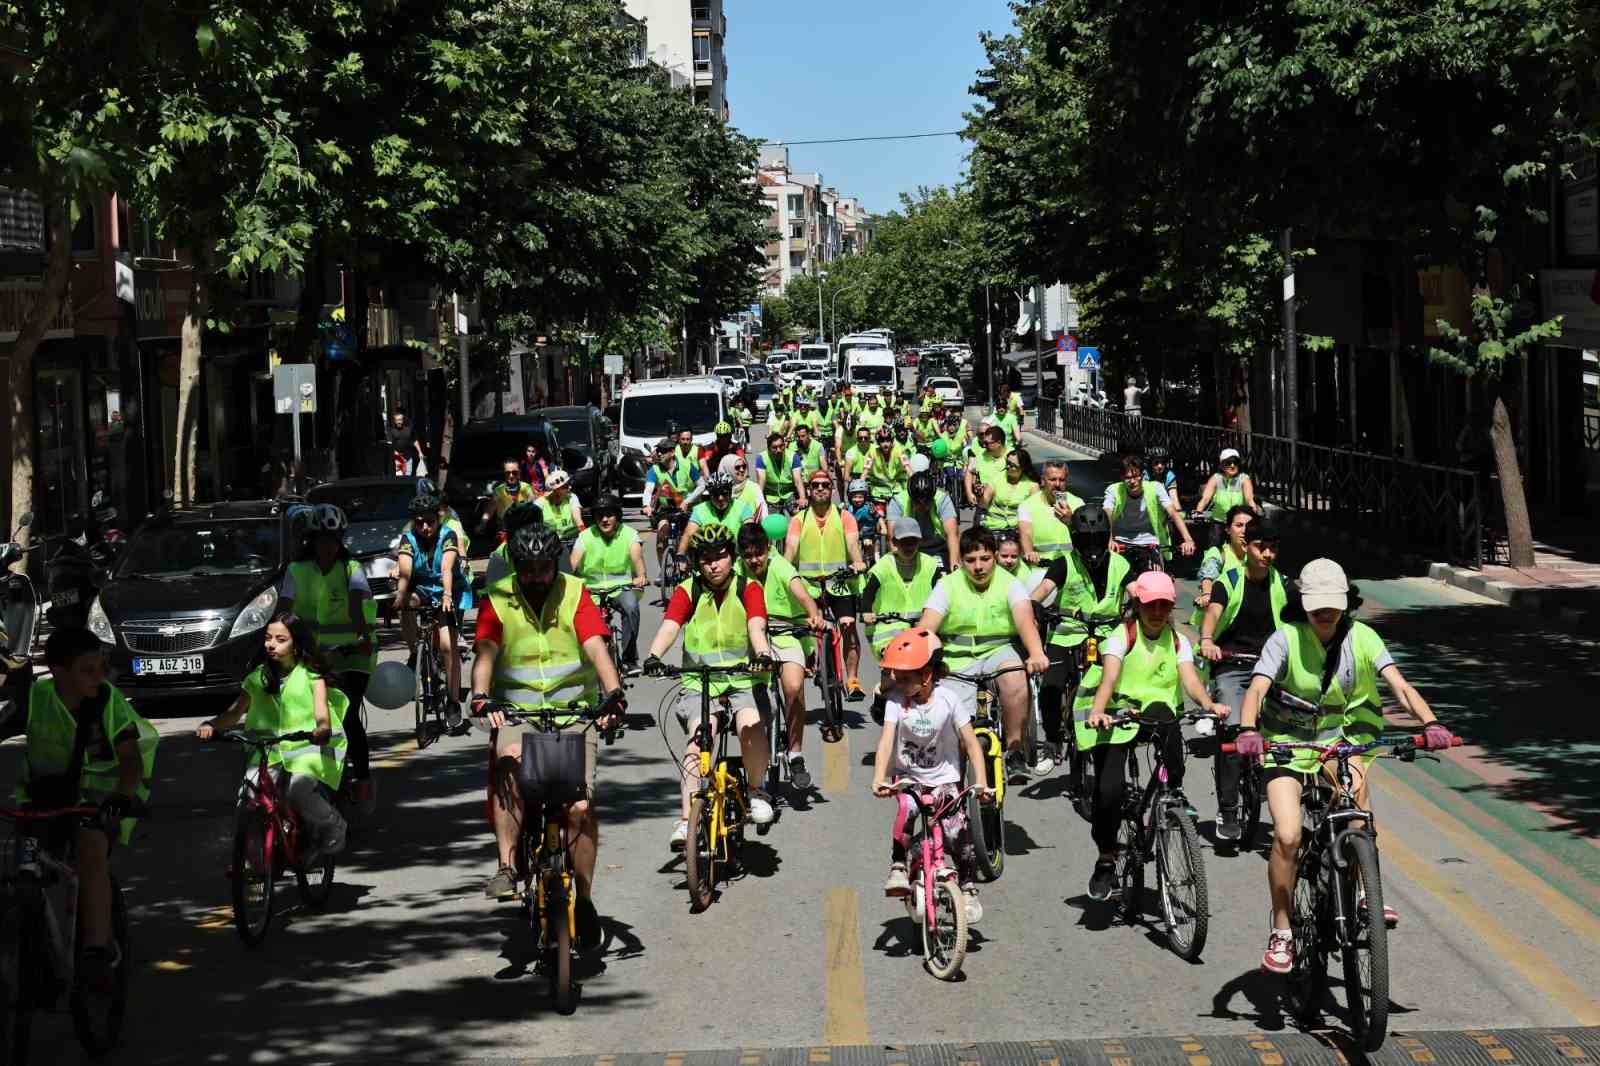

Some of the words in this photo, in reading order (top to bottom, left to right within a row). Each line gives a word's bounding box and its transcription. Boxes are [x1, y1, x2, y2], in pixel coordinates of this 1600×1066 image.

[141, 660, 153, 672] 35
[159, 659, 178, 671] AGZ
[182, 658, 202, 671] 318
